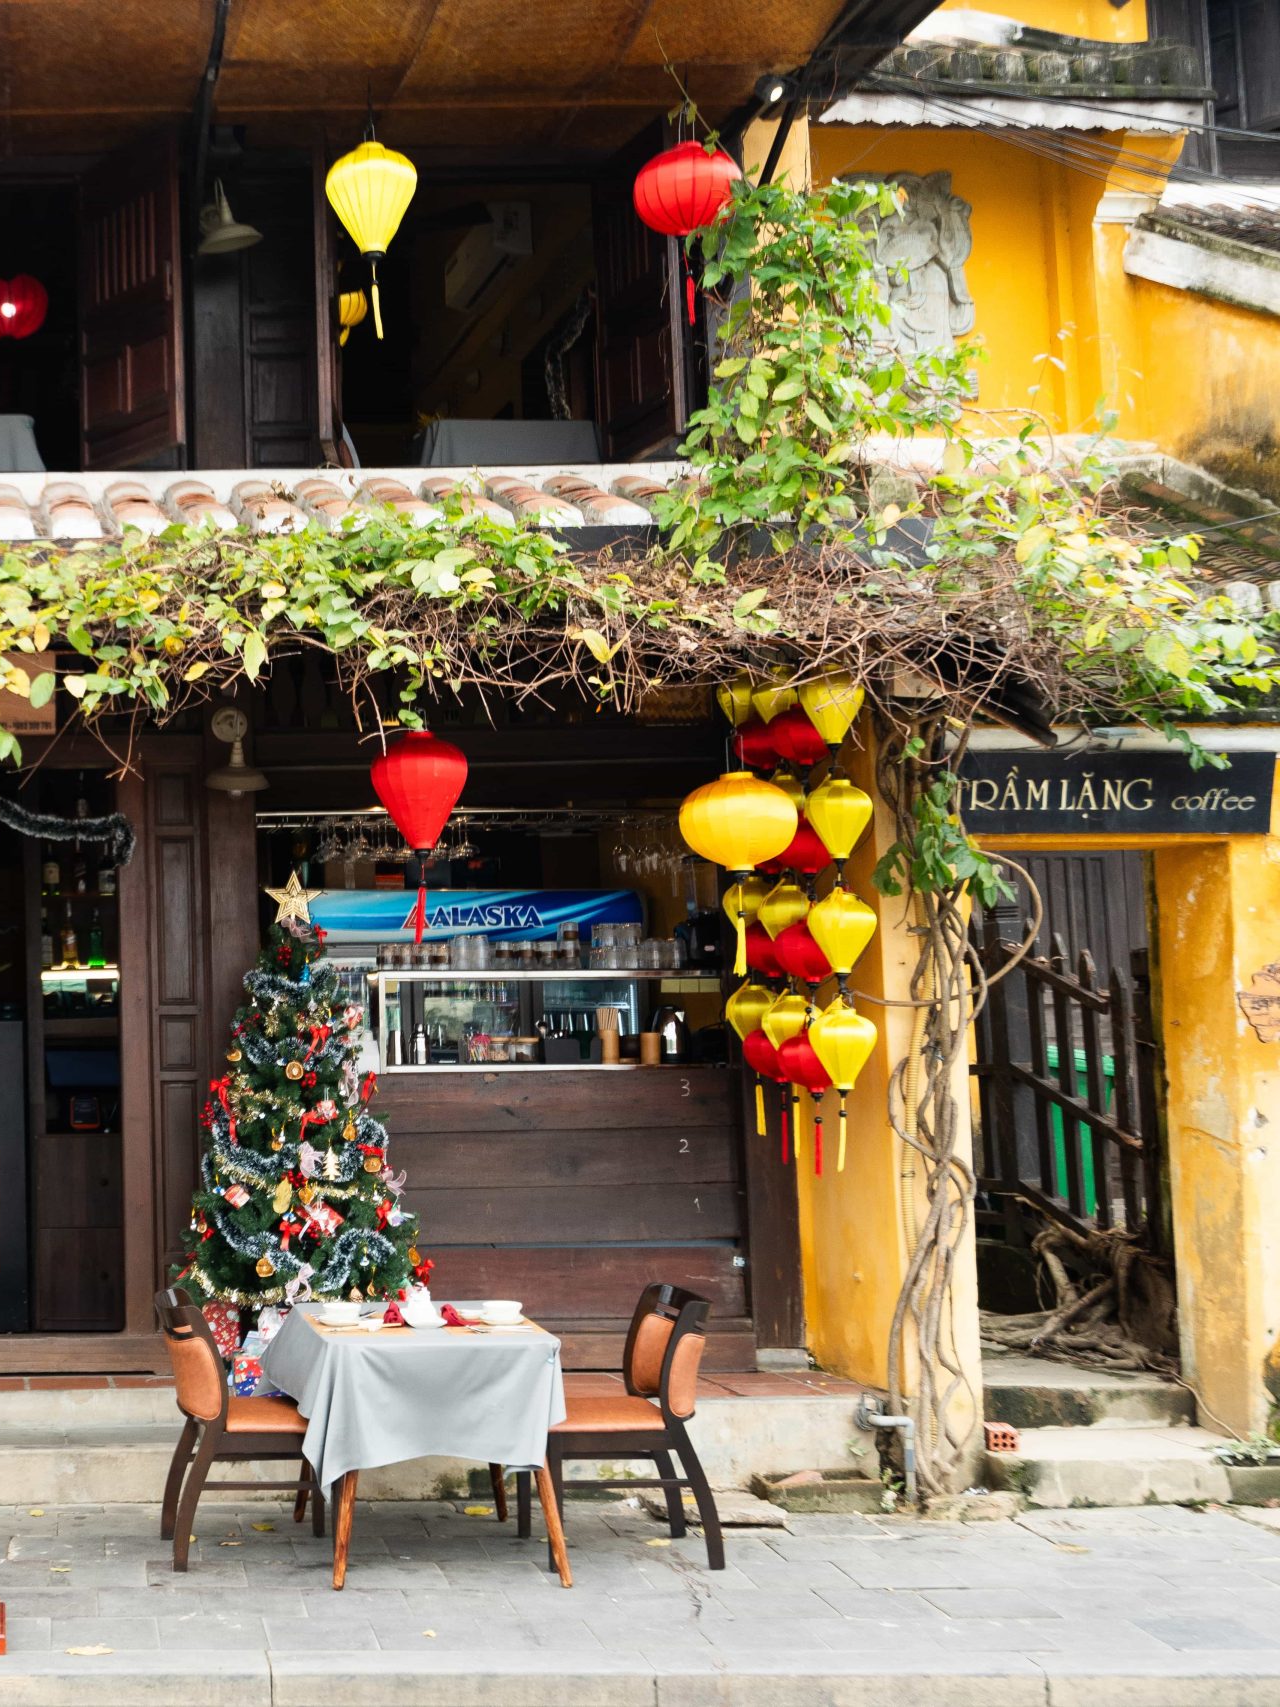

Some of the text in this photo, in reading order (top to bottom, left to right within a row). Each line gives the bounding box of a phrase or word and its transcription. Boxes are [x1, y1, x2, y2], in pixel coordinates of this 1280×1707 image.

[1058, 772, 1154, 819] LẶNG
[1171, 788, 1256, 811] coffee
[431, 905, 544, 928] ALASKA
[679, 1078, 691, 1097] 3
[679, 1138, 690, 1153] 2
[693, 1197, 704, 1213] 1
